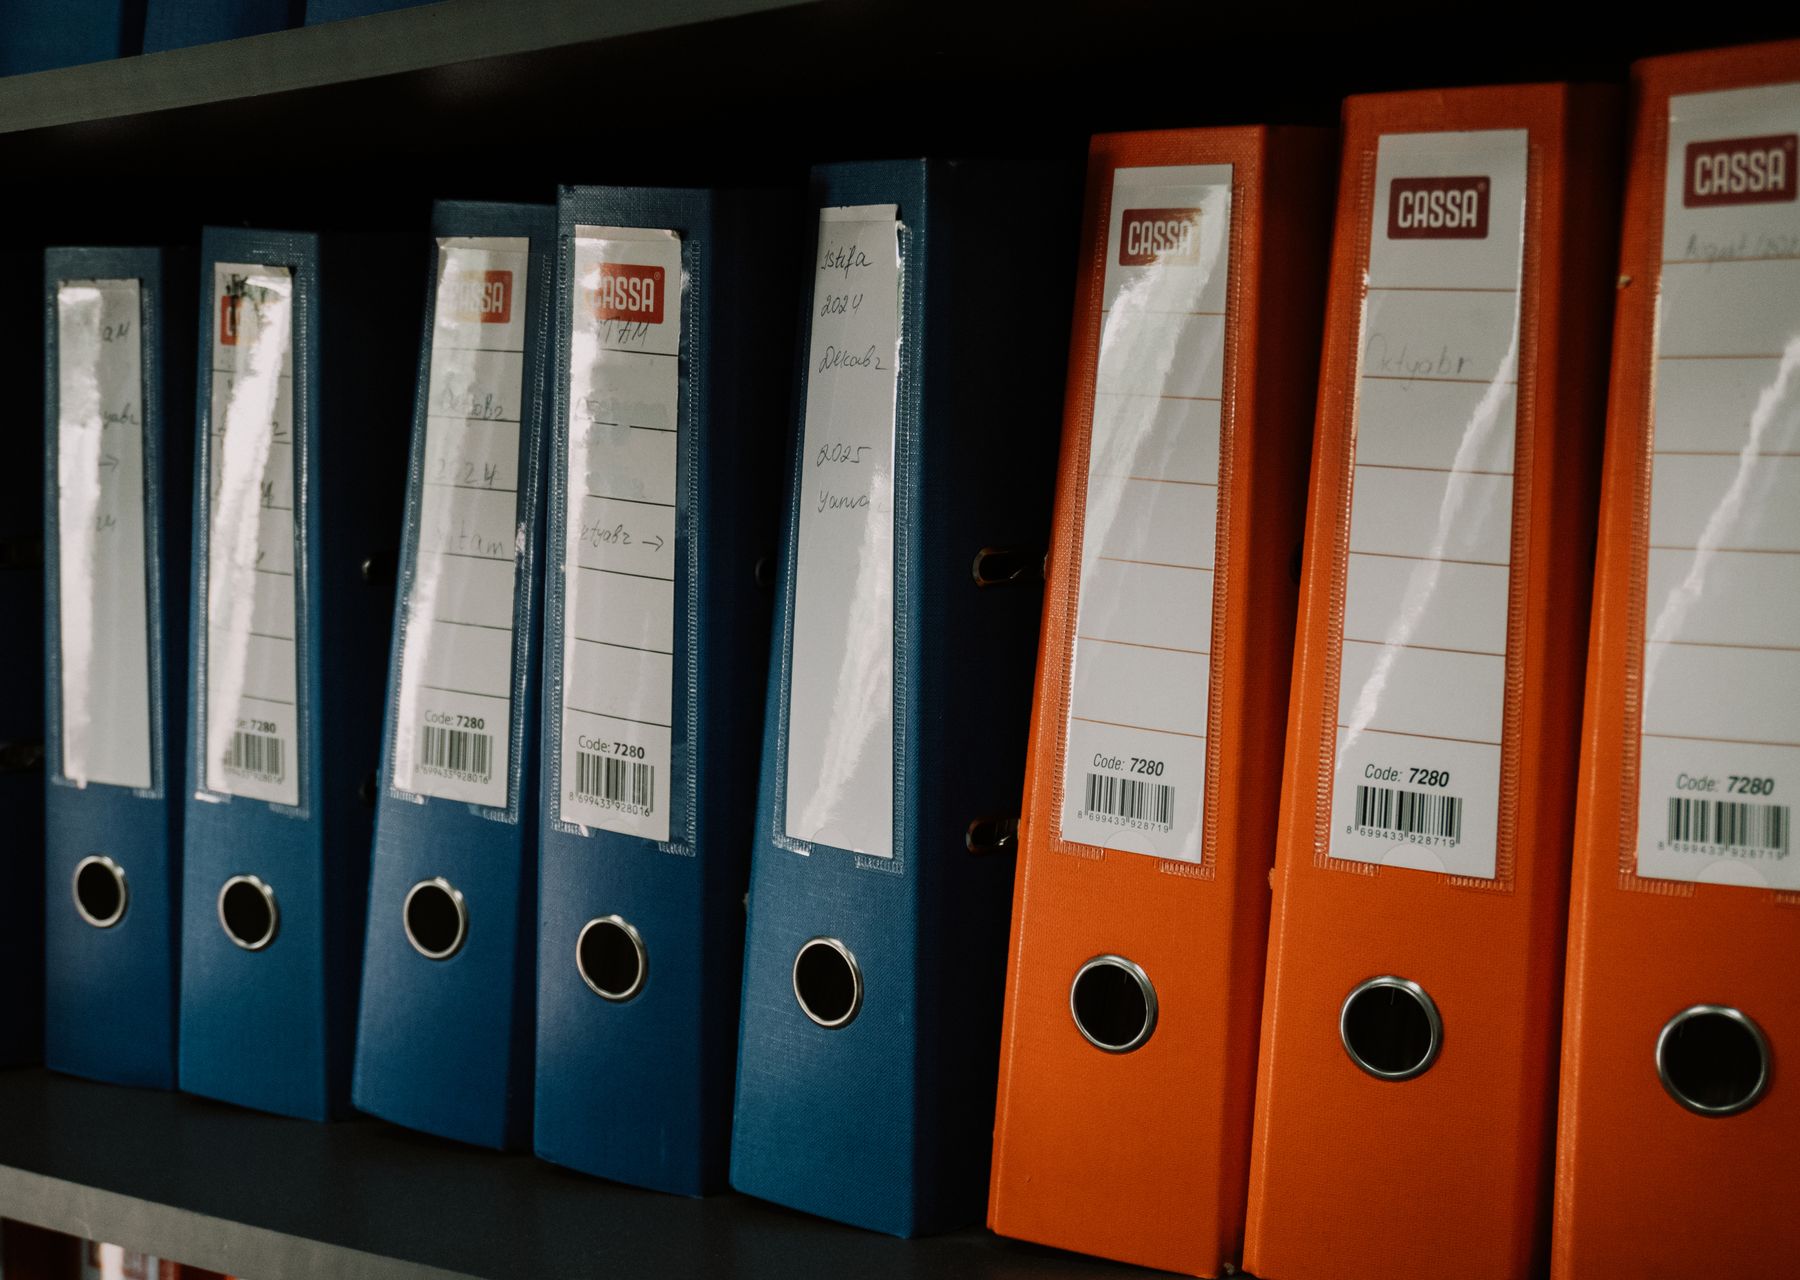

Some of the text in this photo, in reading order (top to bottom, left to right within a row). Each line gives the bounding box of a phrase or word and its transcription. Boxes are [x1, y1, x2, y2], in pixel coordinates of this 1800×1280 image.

[1695, 148, 1786, 197] CASSA
[1397, 189, 1479, 229] CASSA
[1127, 220, 1193, 257] CASSA
[820, 293, 864, 318] 2024
[816, 442, 873, 468] 2025
[250, 719, 277, 734] 7280
[424, 709, 486, 731] Code: 7280
[578, 735, 646, 760] Code: 7280
[1093, 753, 1165, 777] Code: 7280
[1364, 763, 1451, 788] Code: 7280
[1676, 772, 1776, 797] Code: 7280
